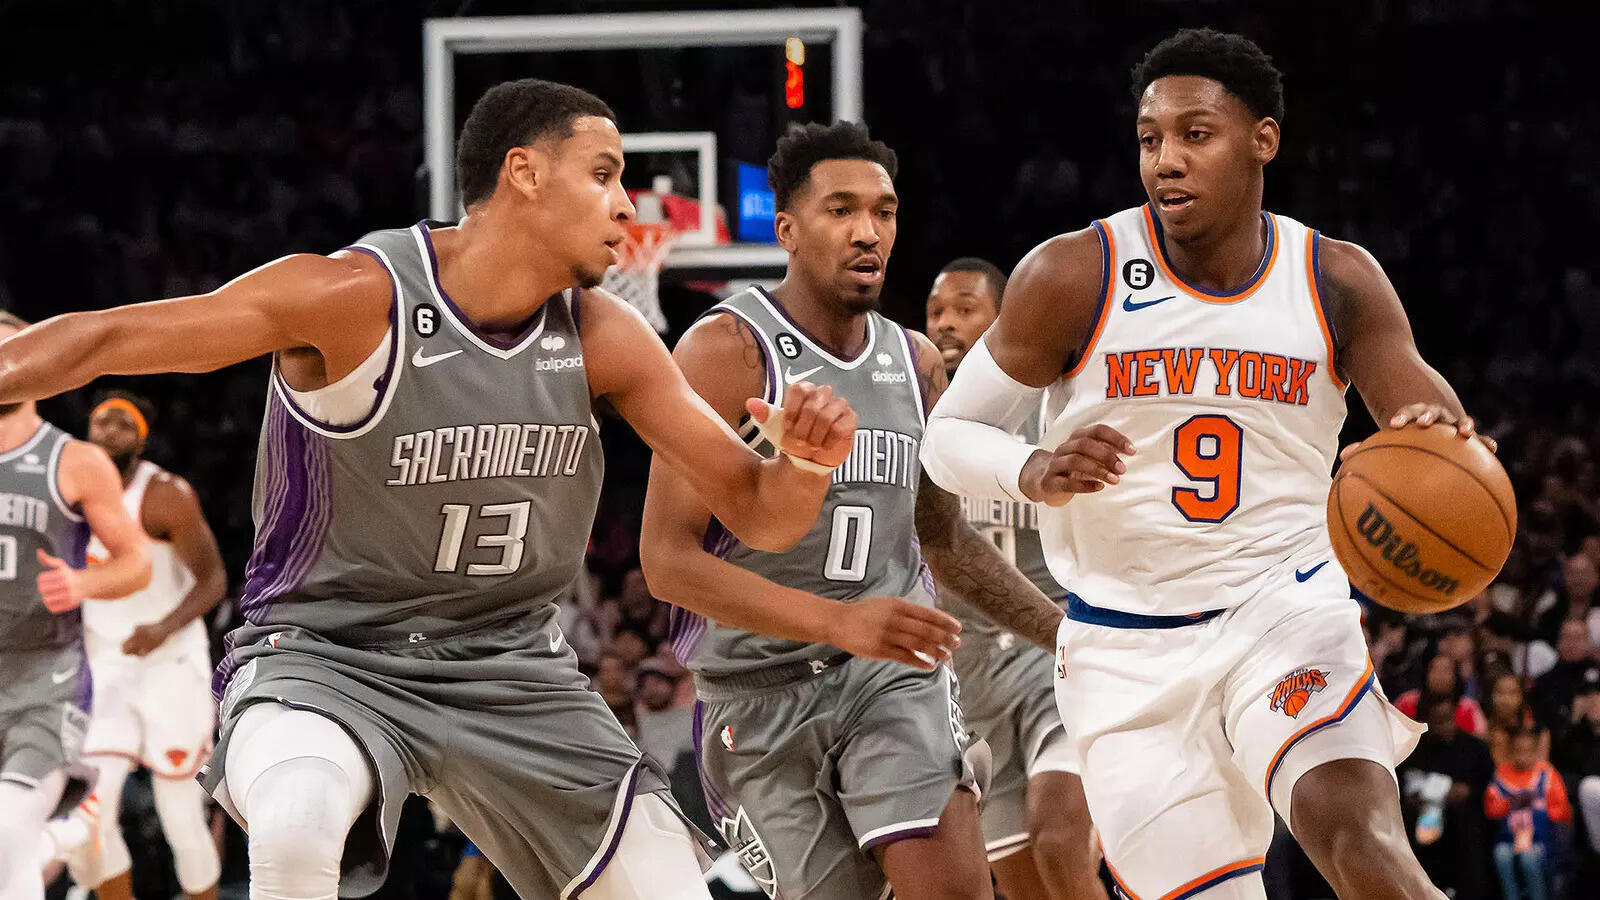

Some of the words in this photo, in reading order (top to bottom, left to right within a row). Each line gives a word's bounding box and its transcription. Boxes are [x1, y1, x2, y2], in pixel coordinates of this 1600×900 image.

[1129, 263, 1148, 286] 6
[416, 307, 435, 335] 6
[779, 335, 798, 358] 6
[1106, 347, 1202, 399] NEW
[1208, 348, 1318, 406] YORK
[385, 423, 590, 487] SACRAMENTO
[1171, 413, 1244, 524] 9
[432, 501, 533, 577] 13
[823, 504, 873, 582] 0
[1357, 502, 1460, 595] Wilson
